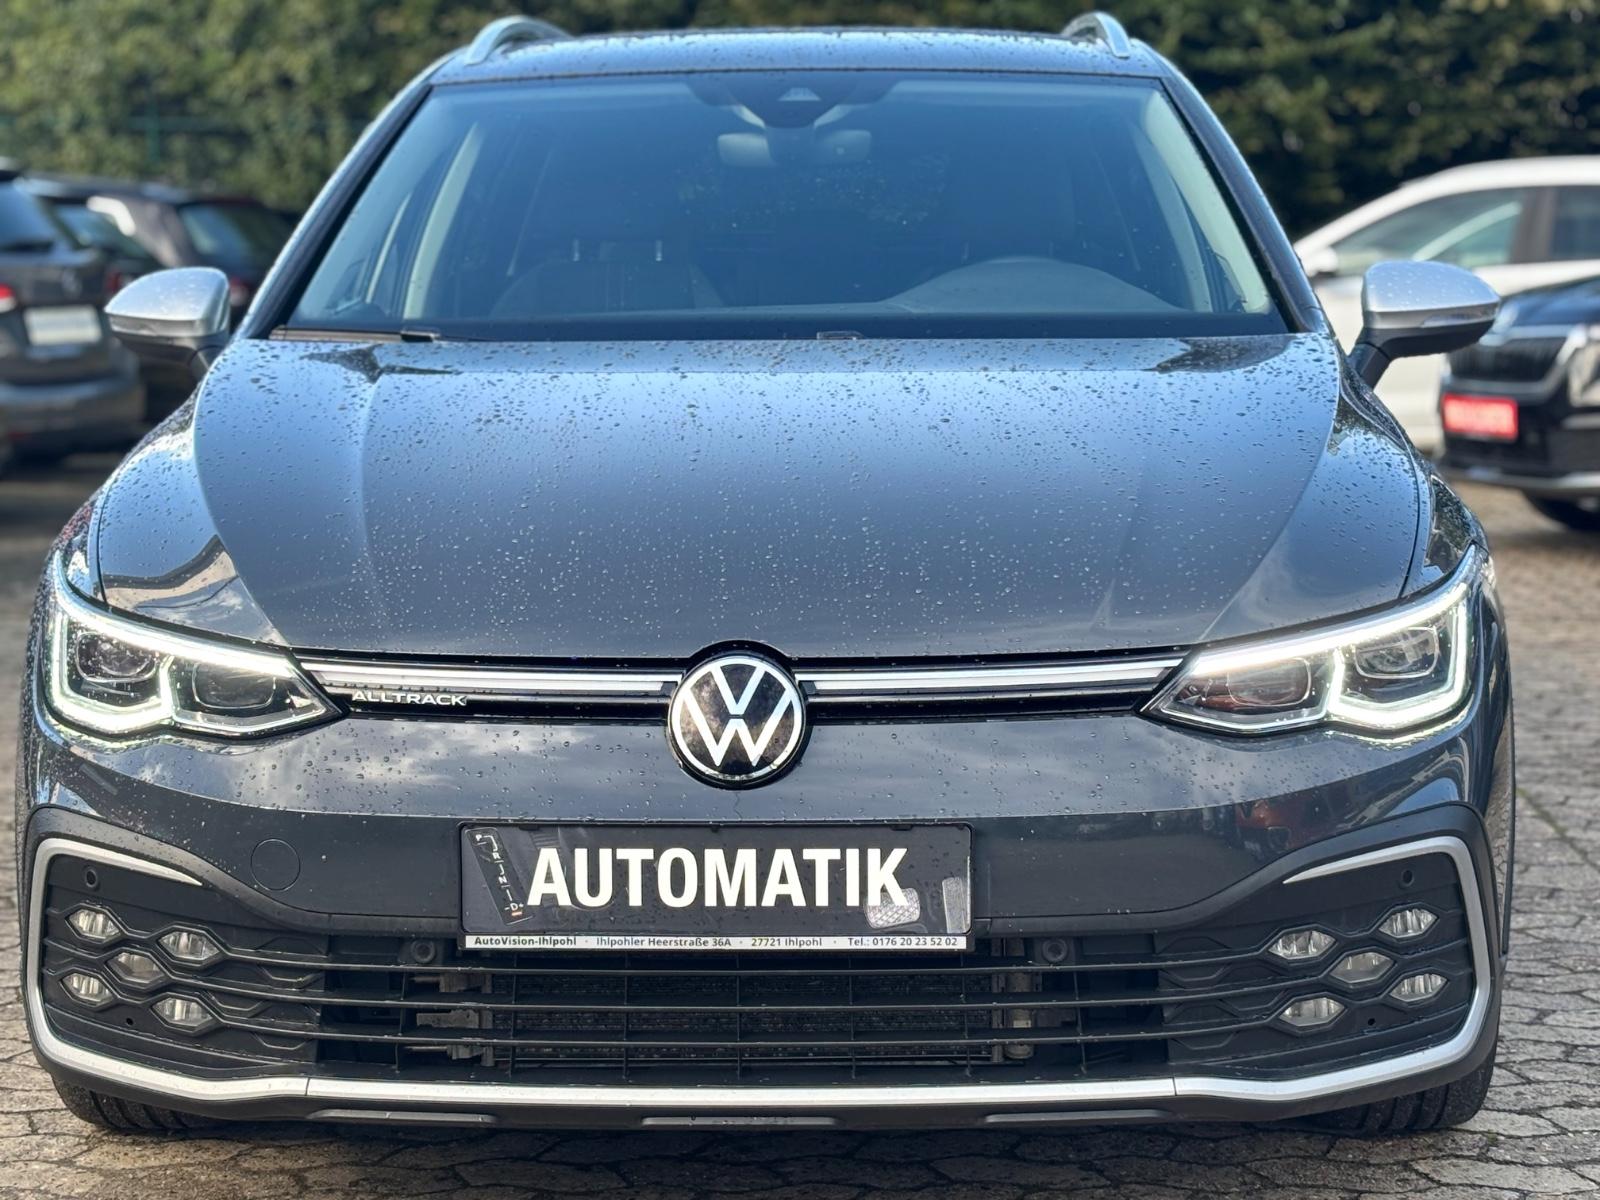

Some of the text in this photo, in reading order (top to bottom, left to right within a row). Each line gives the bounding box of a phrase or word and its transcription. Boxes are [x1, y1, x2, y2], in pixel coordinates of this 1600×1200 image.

[351, 690, 467, 706] ALLTRACK
[682, 660, 794, 768] VW
[527, 846, 908, 908] AUTOMATIK
[474, 936, 958, 948] AutoVision-Ihlpohl Ihlpohler Heerstraße 36A 27721 Ihlpohl Tel.: 0176 20 23 52 02
